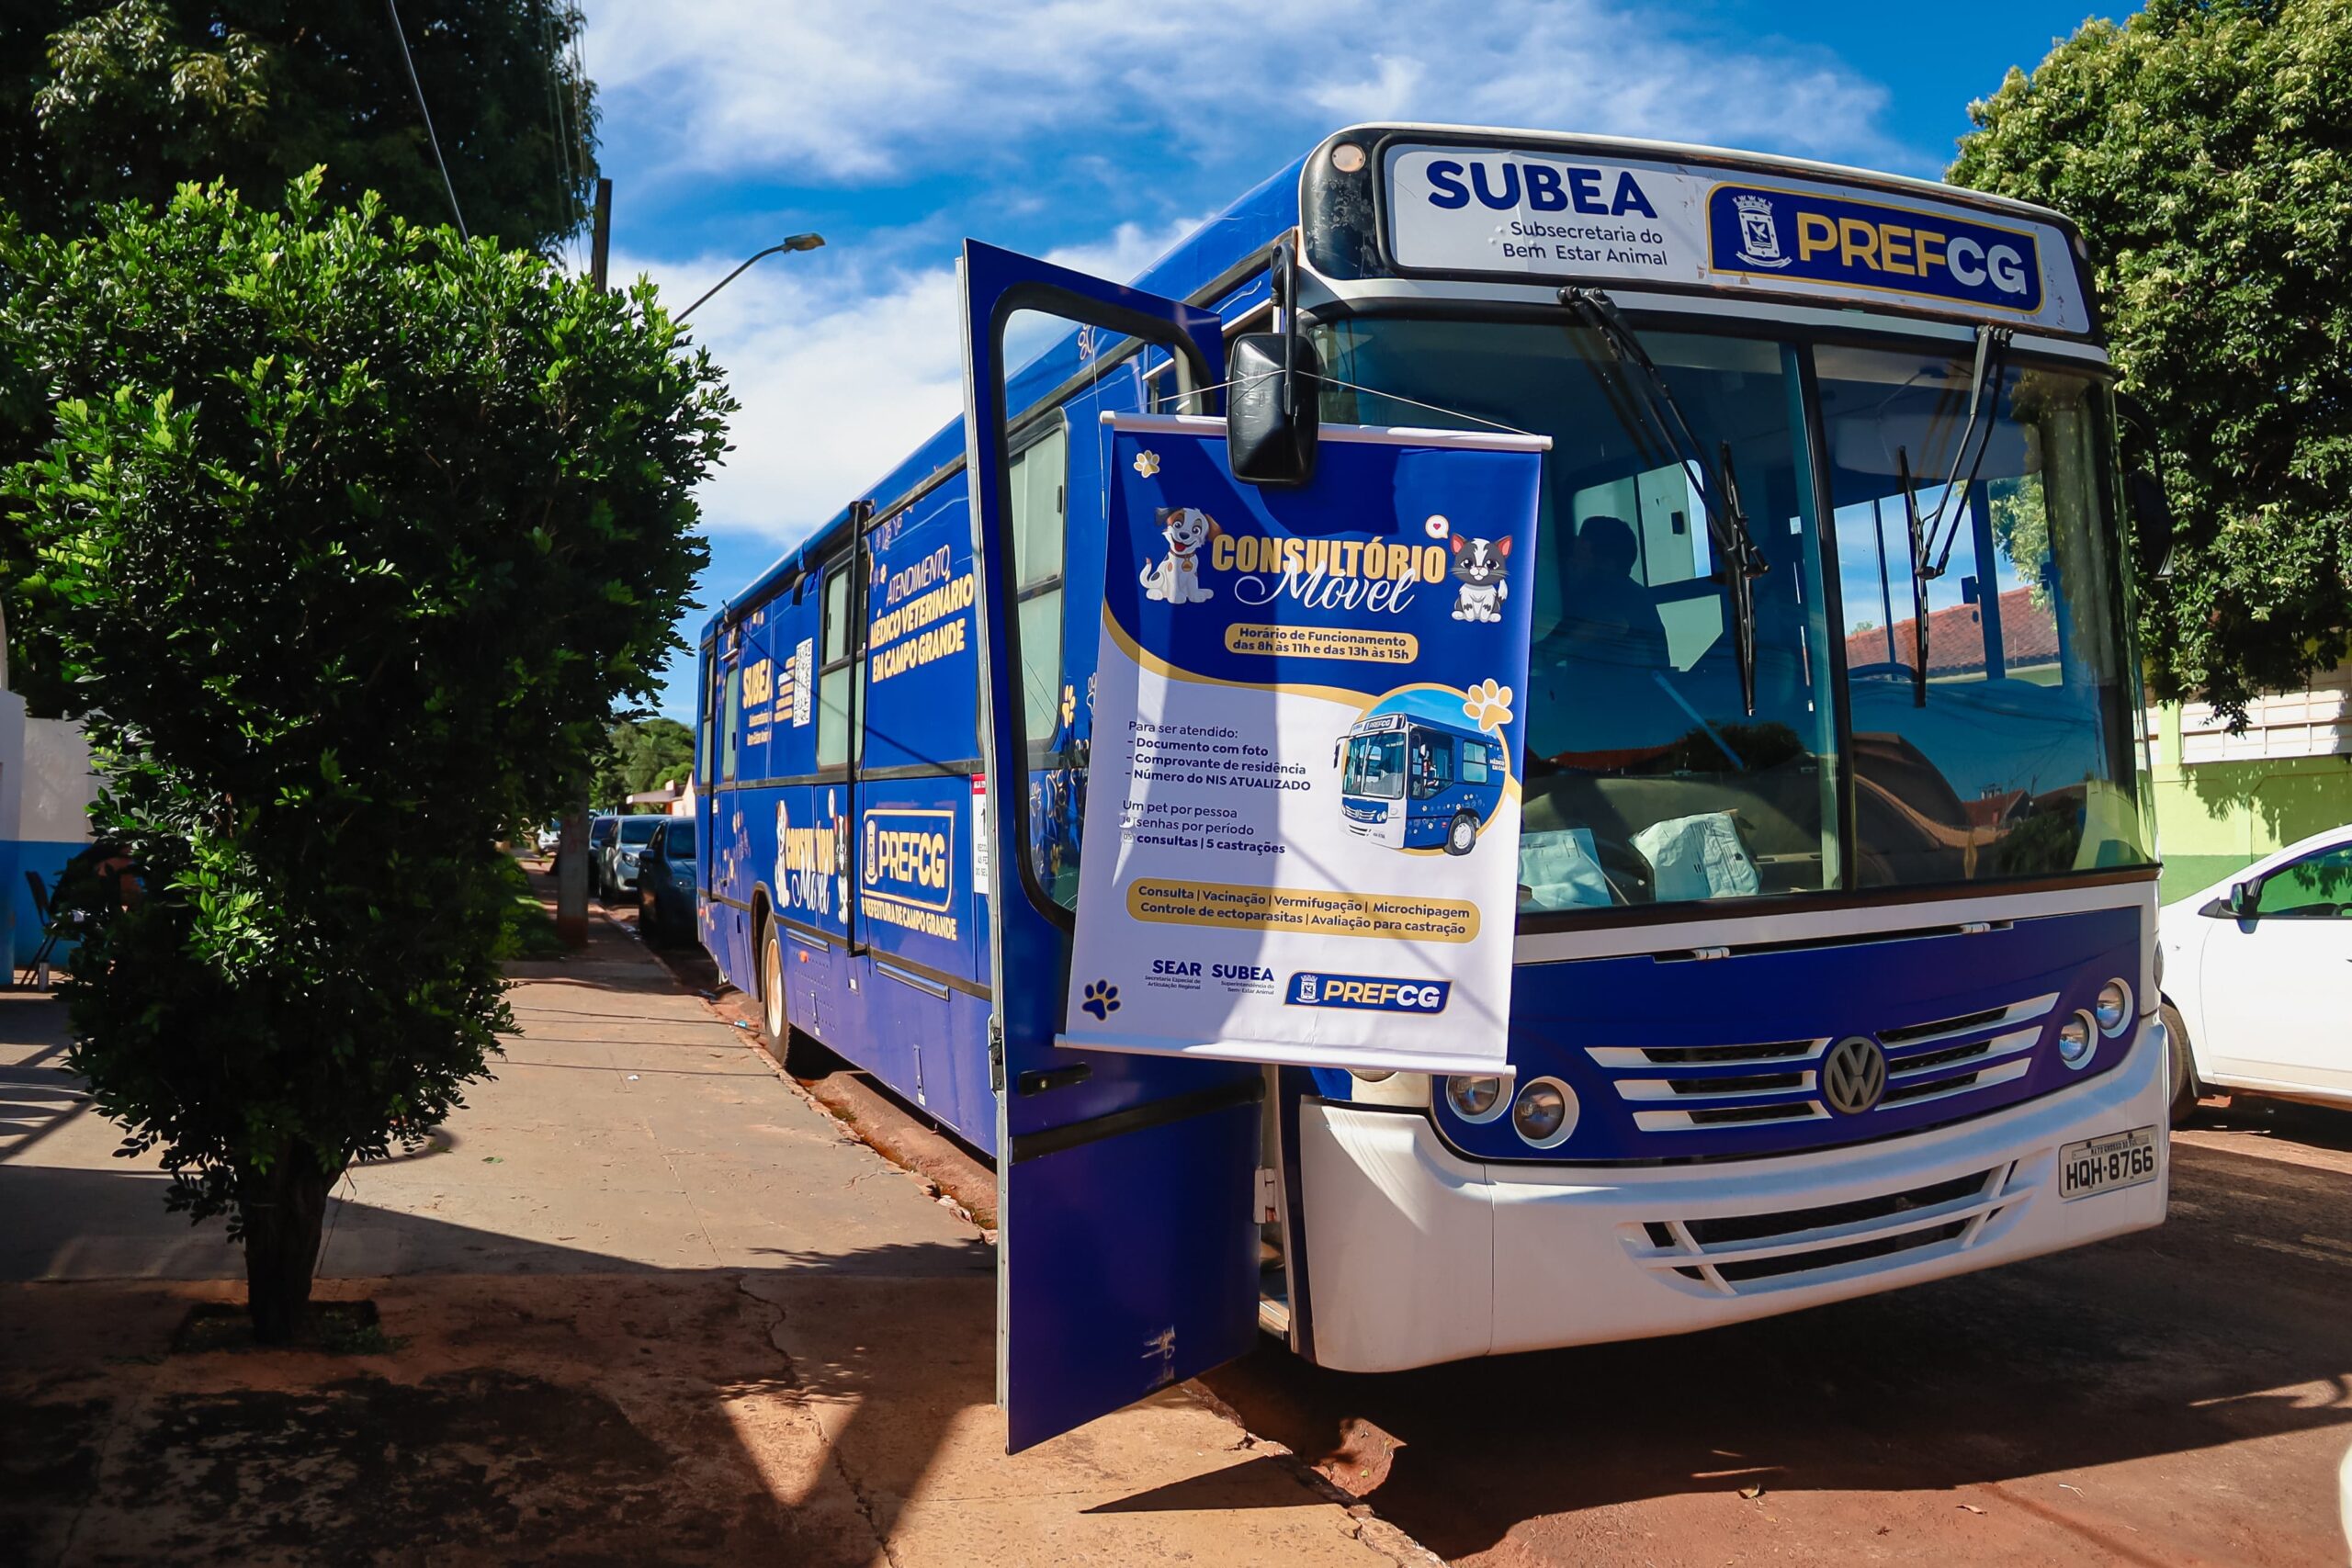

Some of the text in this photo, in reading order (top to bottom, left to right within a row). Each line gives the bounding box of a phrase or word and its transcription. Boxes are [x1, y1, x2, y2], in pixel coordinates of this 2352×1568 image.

[1425, 161, 1657, 220] SUBEA
[1510, 221, 1664, 244] Subsecretaria do
[1502, 243, 1668, 265] Bem Estar Animal
[1797, 213, 2026, 296] PREFCG
[1212, 534, 1446, 584] CONSULTÓRIO
[886, 544, 951, 607] ATENDIMENTO
[1235, 555, 1416, 614] Móvel
[869, 570, 975, 650] MÉDICO VETERINÁRIO
[1239, 627, 1407, 647] Horário de Funcionamento
[872, 618, 966, 683] EM CAMPO GRANDE
[1232, 639, 1409, 660] das 8h às 11h e das 13h às 15h
[1128, 721, 1238, 739] Para ser atendido:
[1136, 738, 1210, 752] Documento
[1212, 744, 1239, 754] com
[1242, 744, 1269, 756] foto
[1135, 753, 1221, 769] Comprovante
[1223, 760, 1239, 771] de
[1241, 761, 1306, 774] residência
[1134, 768, 1184, 783] Número
[1186, 773, 1204, 784] do
[1205, 774, 1227, 785] NIS
[1228, 776, 1311, 791] ATUALIZADO
[1123, 800, 1238, 818] Um pet por pessoa
[1136, 818, 1180, 830] senhas
[1182, 821, 1204, 832] por
[1205, 822, 1255, 835] período
[1136, 835, 1198, 848] consultas
[1206, 839, 1215, 848] 5
[1216, 840, 1286, 855] castrações
[878, 830, 946, 888] PREFCG
[1138, 886, 1194, 899] Consulta
[1203, 890, 1266, 907] Vacinação
[1274, 896, 1363, 913] Vermifugação
[1373, 902, 1470, 919] Microchipagem
[903, 907, 926, 932] CAMPO
[926, 912, 957, 942] GRANDE
[1140, 902, 1195, 916] Controle
[1198, 906, 1215, 917] de
[1216, 909, 1304, 923] ectoparasitas
[1311, 914, 1372, 931] Avaliação
[1374, 919, 1402, 931] para
[1404, 921, 1466, 936] castração
[1152, 959, 1202, 976] SEAR
[1211, 964, 1275, 981] SUBEA
[1324, 979, 1441, 1009] PREFCG
